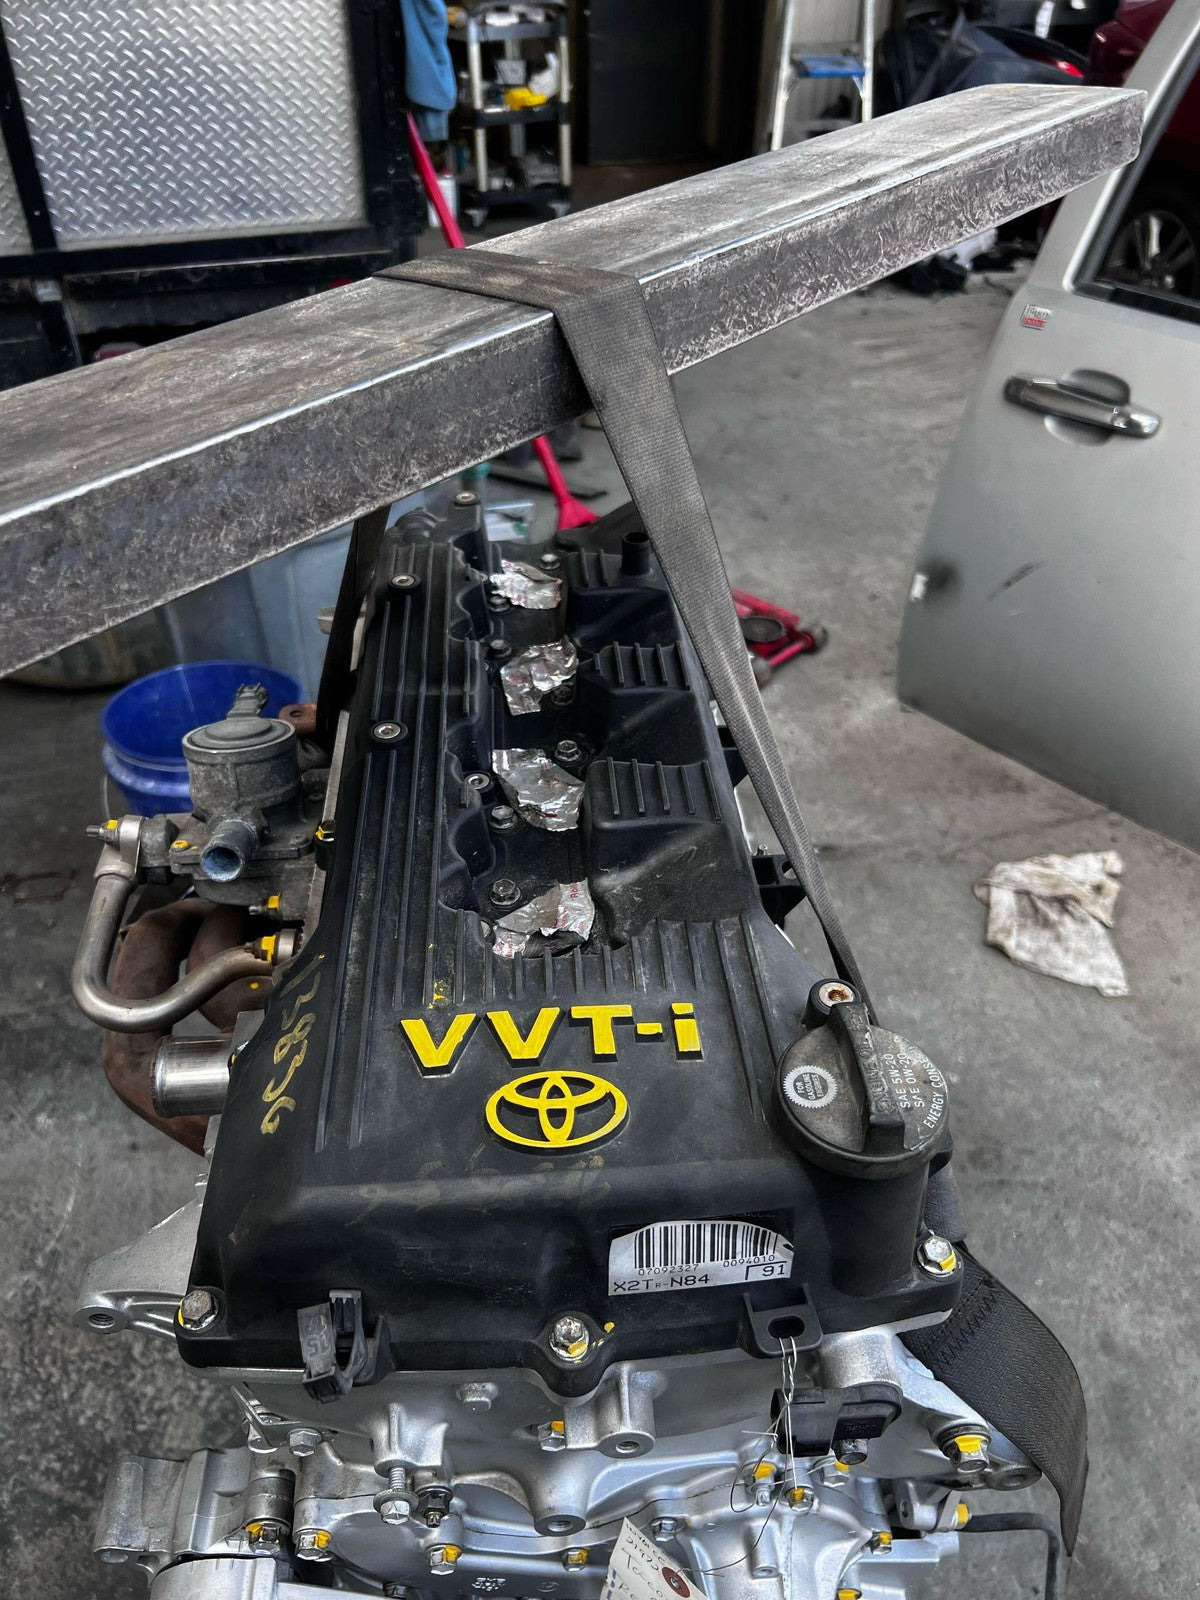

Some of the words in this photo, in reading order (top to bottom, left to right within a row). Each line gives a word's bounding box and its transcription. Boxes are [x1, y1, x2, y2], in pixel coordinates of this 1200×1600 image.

[400, 1002, 701, 1068] VVT-i
[884, 1053, 903, 1085] 5W-20
[795, 1081, 805, 1094] FOR
[896, 1087, 911, 1109] SAE
[910, 1087, 925, 1107] SAE
[923, 1091, 944, 1129] ENERGY
[638, 1263, 699, 1276] 07092327
[723, 1254, 775, 1268] 0094010
[762, 1264, 786, 1277] 91
